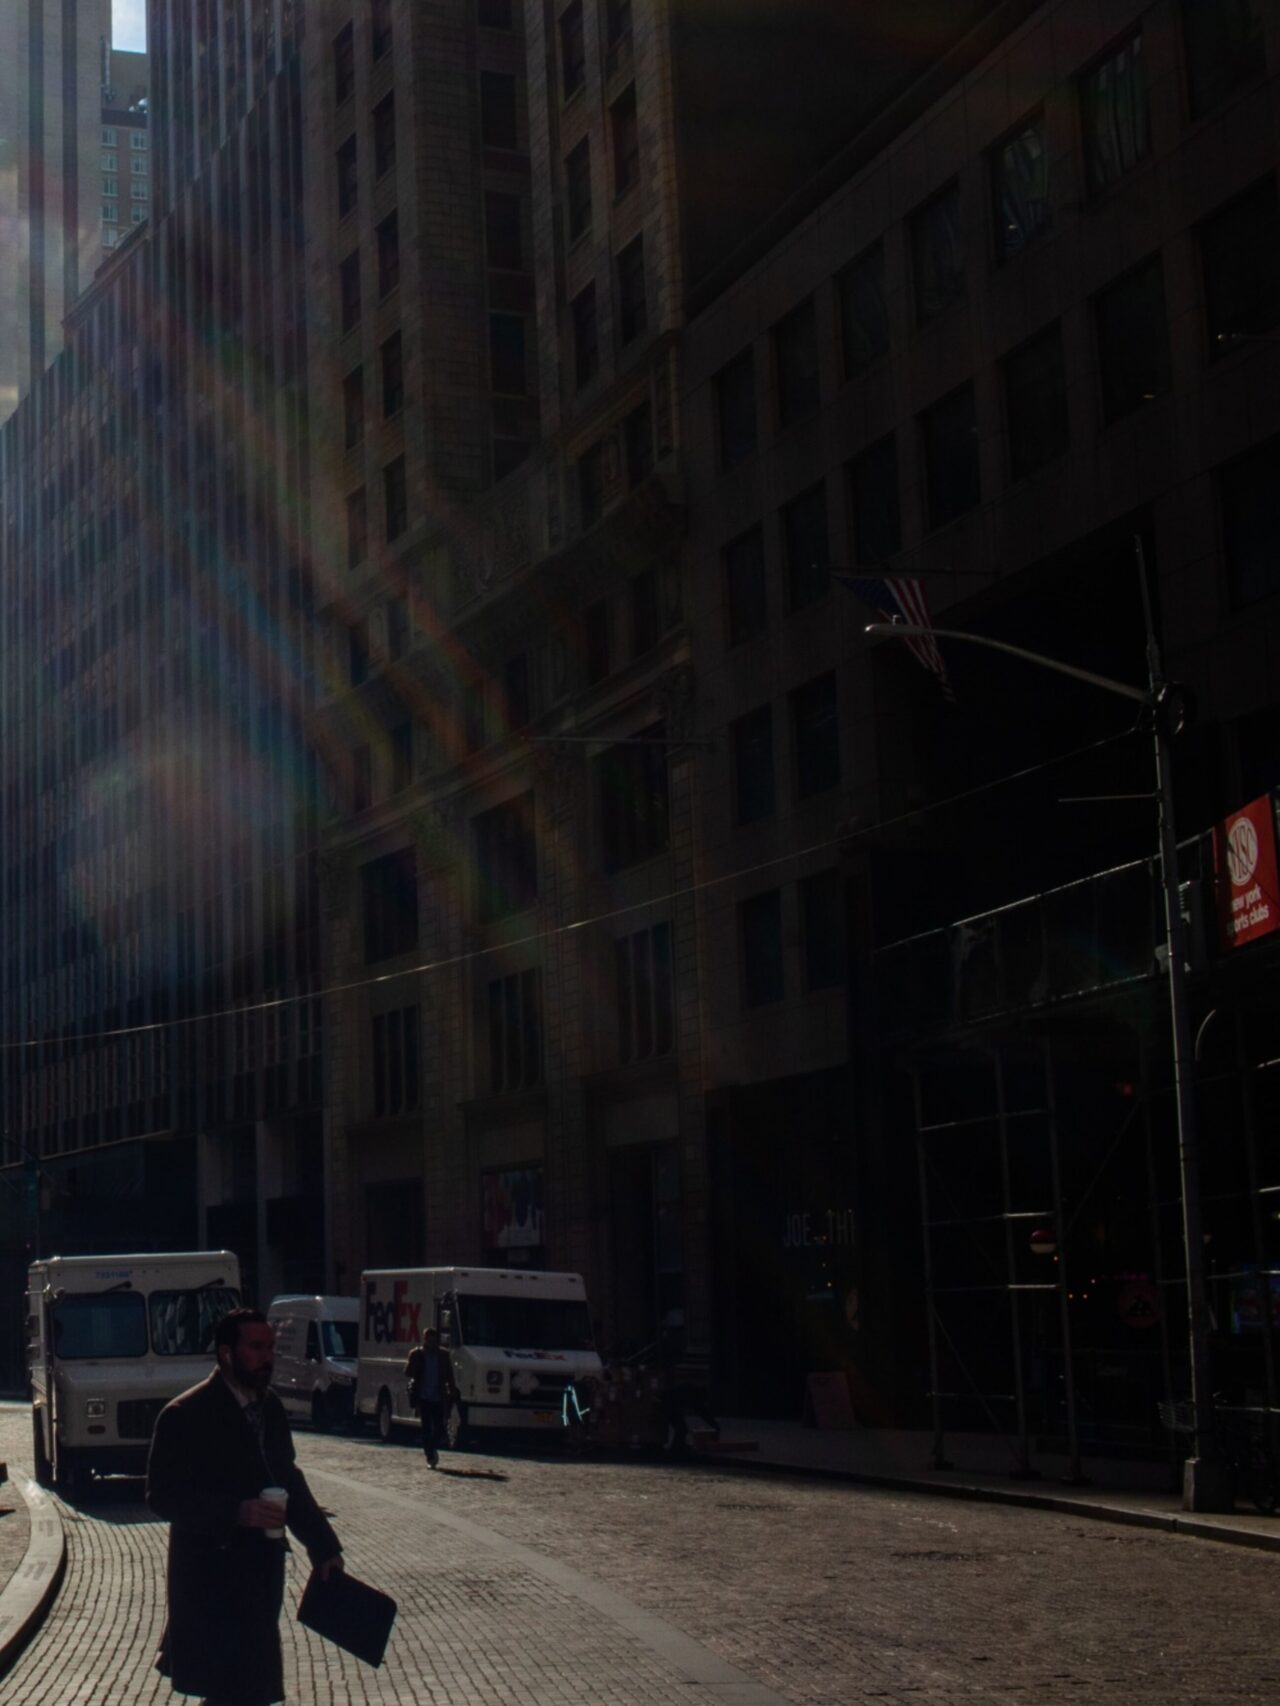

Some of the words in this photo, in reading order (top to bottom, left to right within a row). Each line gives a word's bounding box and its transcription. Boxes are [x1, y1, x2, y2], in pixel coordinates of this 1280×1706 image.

[783, 1213, 813, 1248] JOE
[365, 1280, 422, 1344] FedEx
[503, 1347, 565, 1360] FedEx
